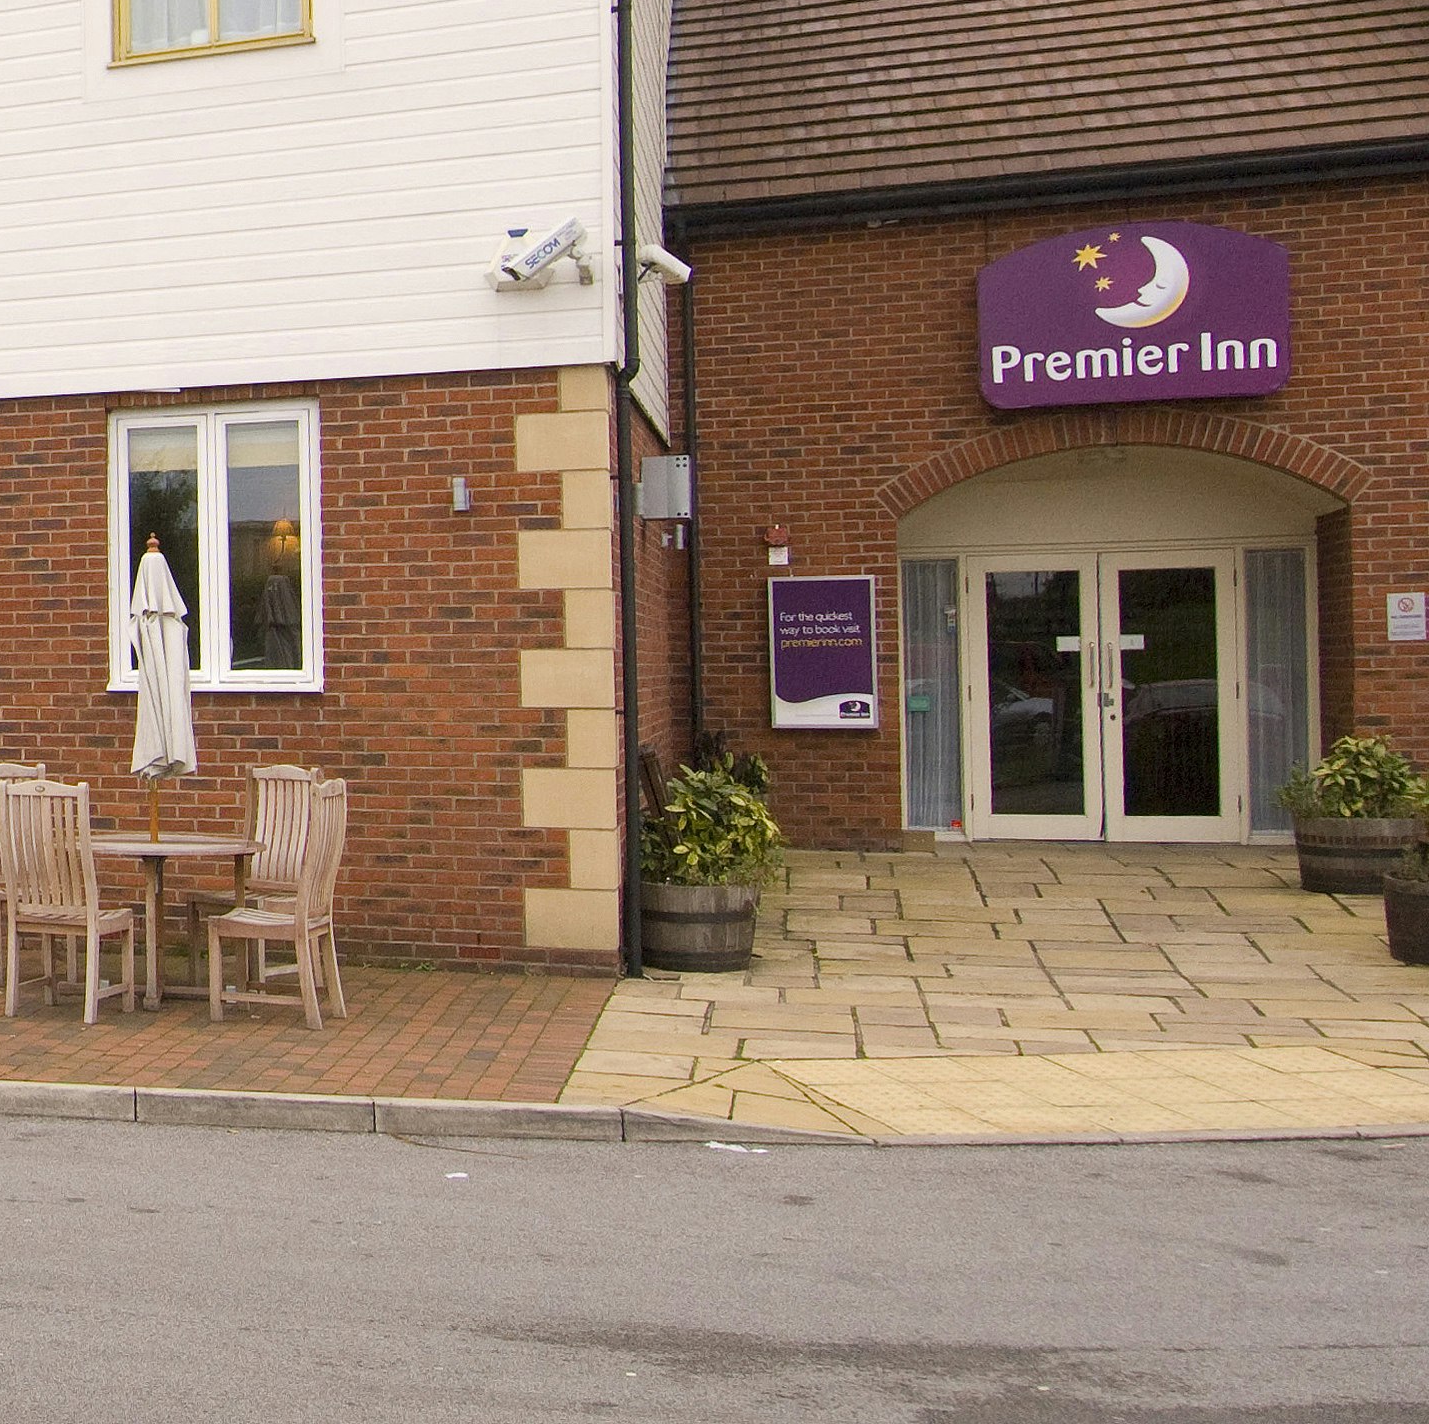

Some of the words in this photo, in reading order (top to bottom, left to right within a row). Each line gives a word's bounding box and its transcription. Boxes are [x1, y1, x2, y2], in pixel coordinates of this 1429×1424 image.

[524, 237, 561, 269] SECOM
[991, 337, 1190, 384] Premier
[1199, 332, 1278, 372] Inn
[780, 612, 796, 622] For
[798, 610, 814, 622] the
[815, 610, 854, 623] quickest
[779, 626, 800, 637] way
[802, 625, 814, 634] to
[815, 624, 840, 634] book
[842, 622, 861, 634] visit
[781, 637, 863, 650] premierinn.com
